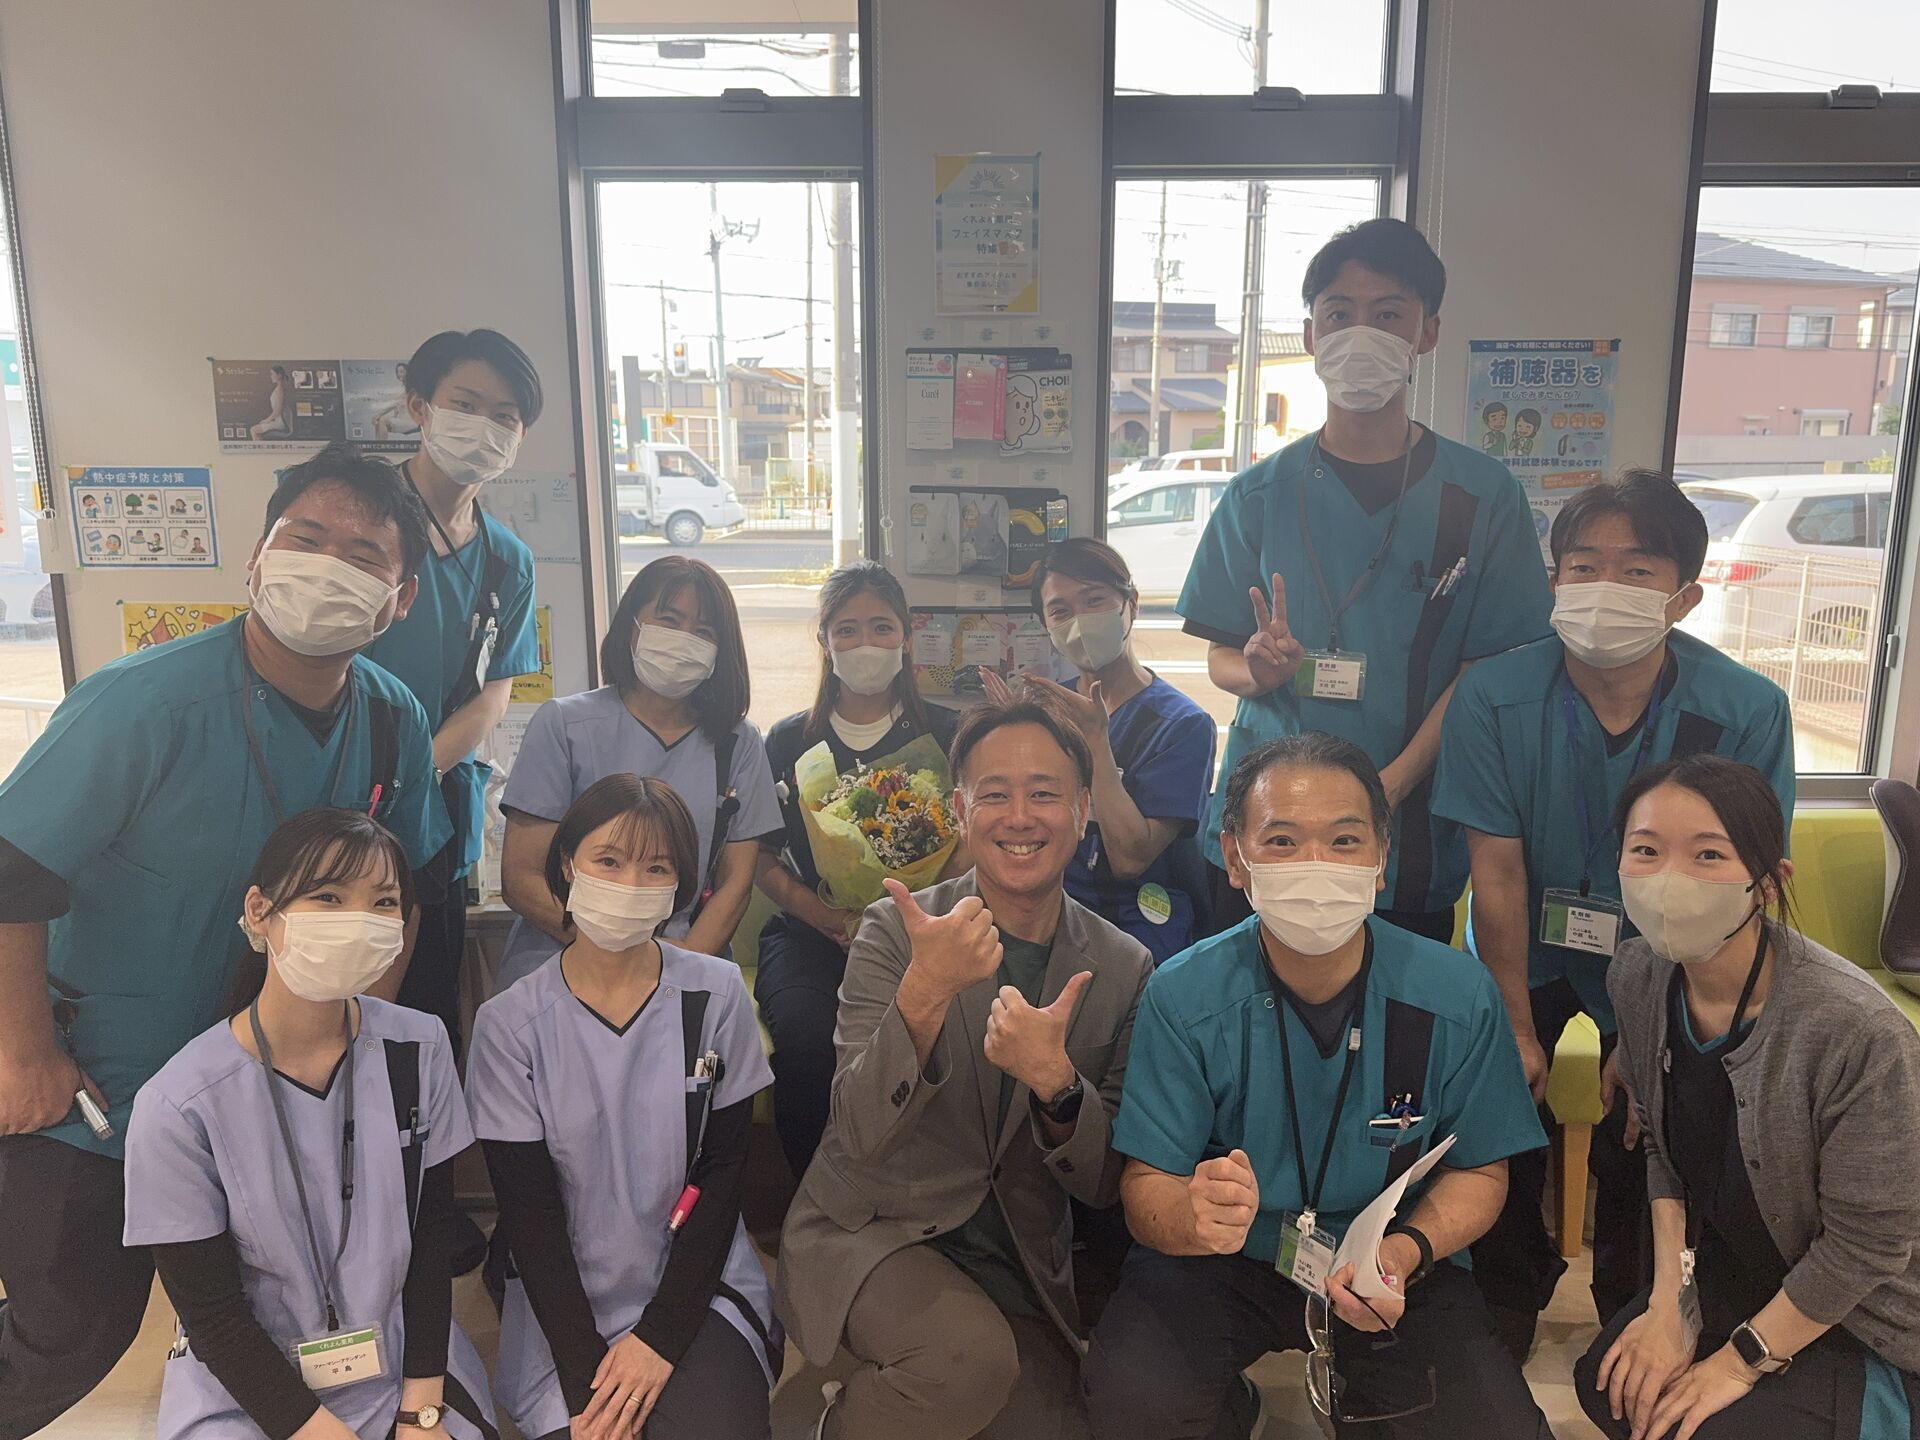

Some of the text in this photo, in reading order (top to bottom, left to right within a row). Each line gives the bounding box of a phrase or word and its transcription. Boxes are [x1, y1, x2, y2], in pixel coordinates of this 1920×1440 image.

[1490, 358, 1601, 386] 補聴器を
[93, 472, 185, 483] 熱中症予防と対策
